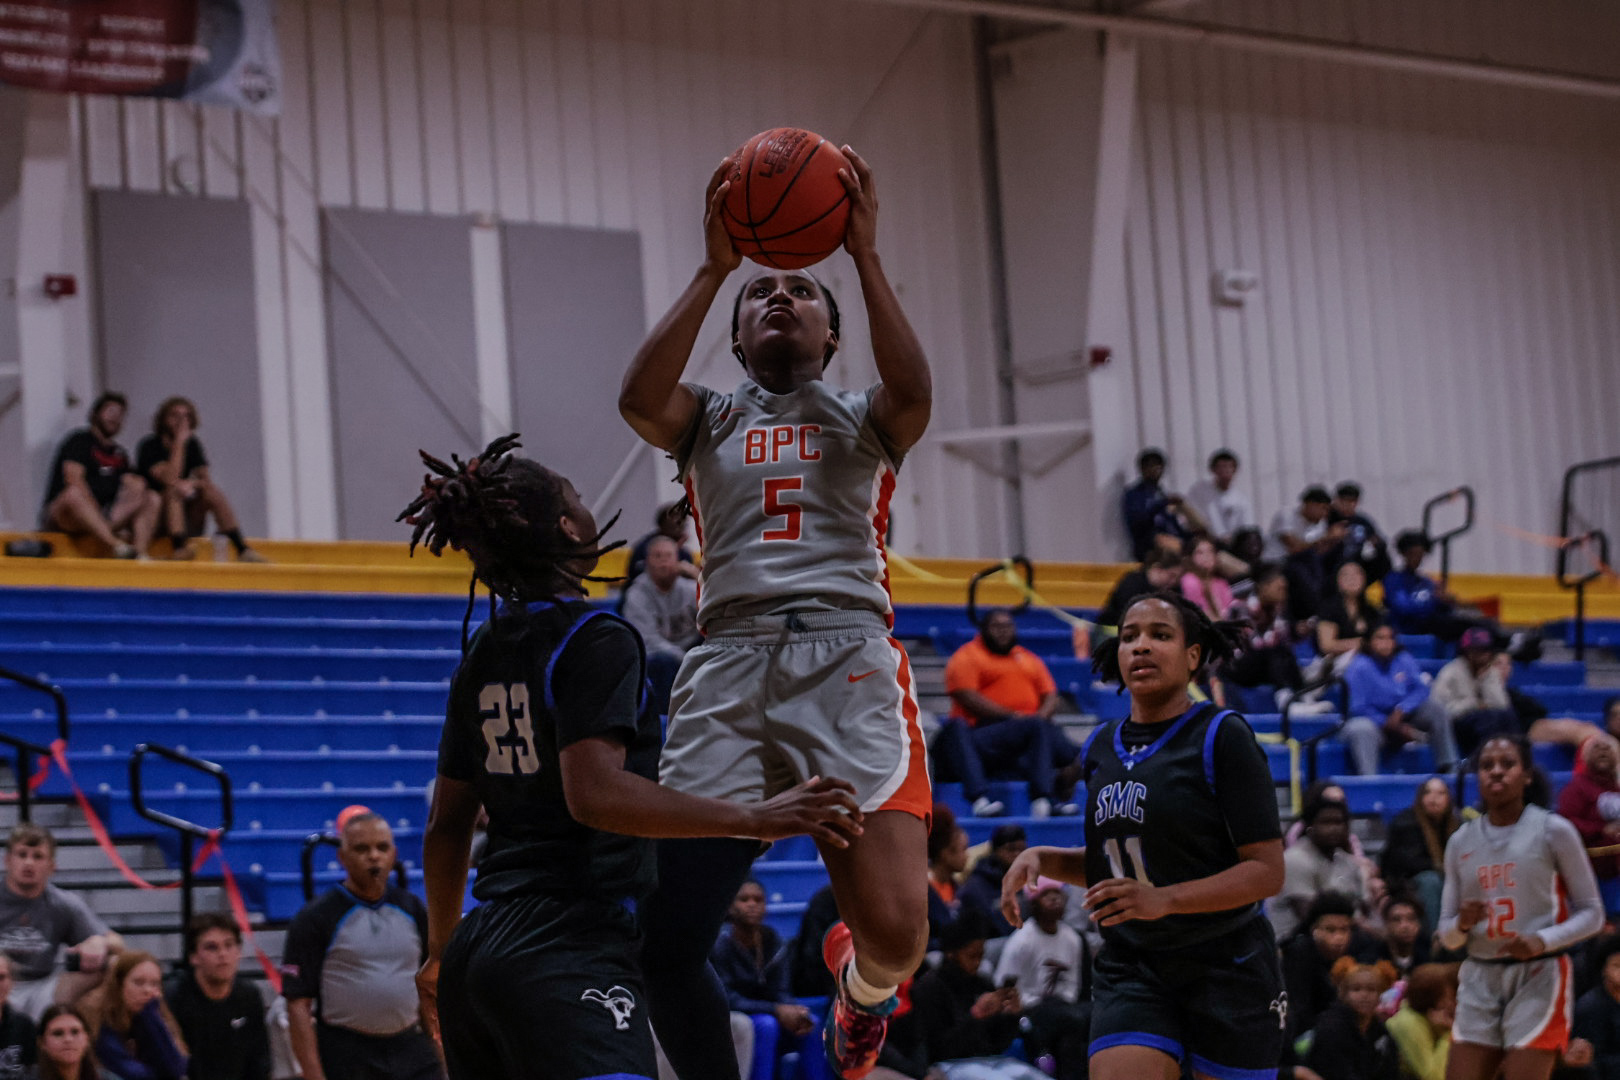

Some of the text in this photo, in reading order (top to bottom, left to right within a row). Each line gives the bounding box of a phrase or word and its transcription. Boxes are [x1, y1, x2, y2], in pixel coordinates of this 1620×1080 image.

[744, 424, 822, 465] BPC
[762, 475, 803, 542] 5
[479, 682, 540, 774] 23
[1095, 781, 1147, 826] SMC
[1103, 836, 1155, 888] 11
[1476, 863, 1516, 889] BPC
[1487, 898, 1517, 939] 12
